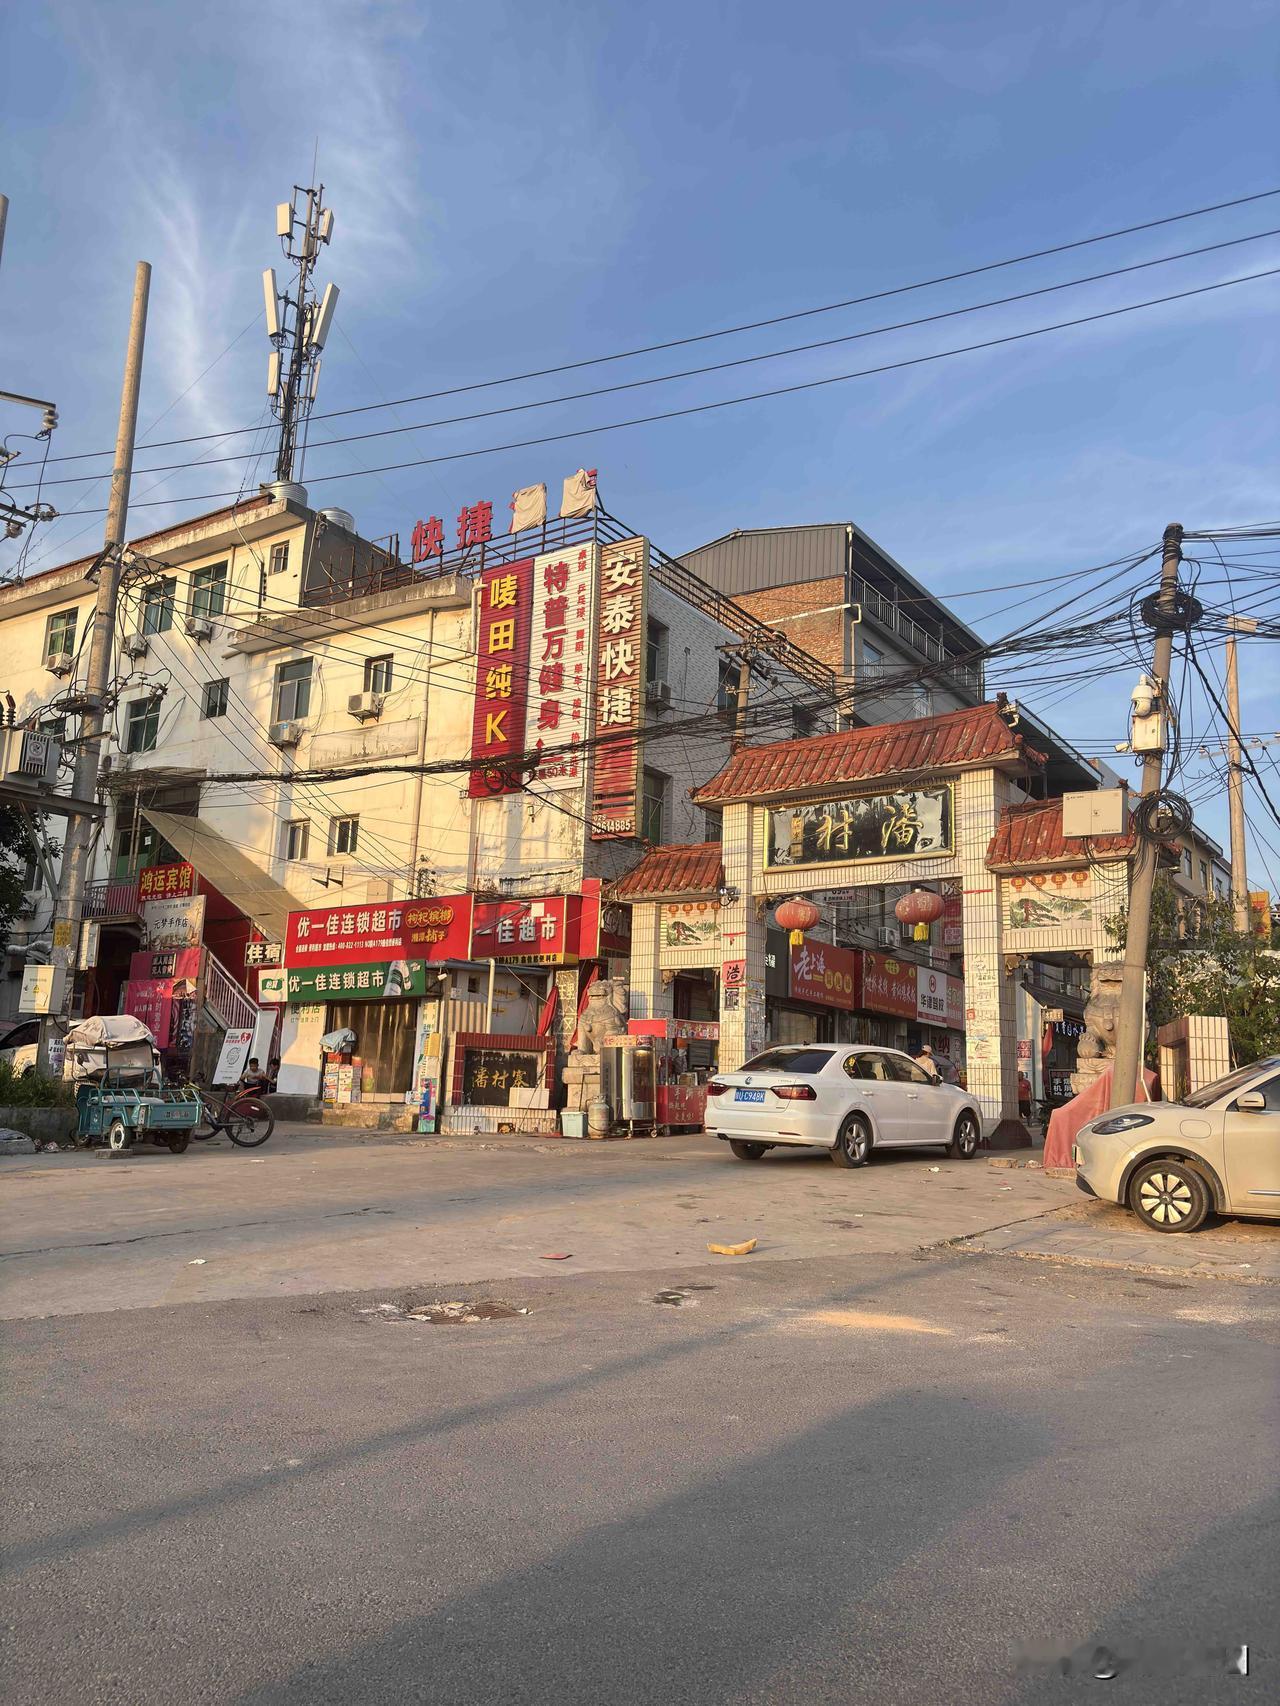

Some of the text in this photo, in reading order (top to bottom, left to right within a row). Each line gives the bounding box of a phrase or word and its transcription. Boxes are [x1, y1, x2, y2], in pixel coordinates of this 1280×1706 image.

[537, 560, 570, 731] 特普万健身
[600, 551, 637, 727] 安泰快捷
[485, 573, 519, 745] 唛田纯K
[141, 865, 192, 894] 鸿运宾馆
[153, 917, 189, 930] 元梦手作店
[297, 908, 402, 939] 优一佳连锁超市
[247, 943, 282, 961] 住宿
[288, 969, 385, 993] 优一佳连锁超市
[472, 1064, 530, 1089] 潘村寨
